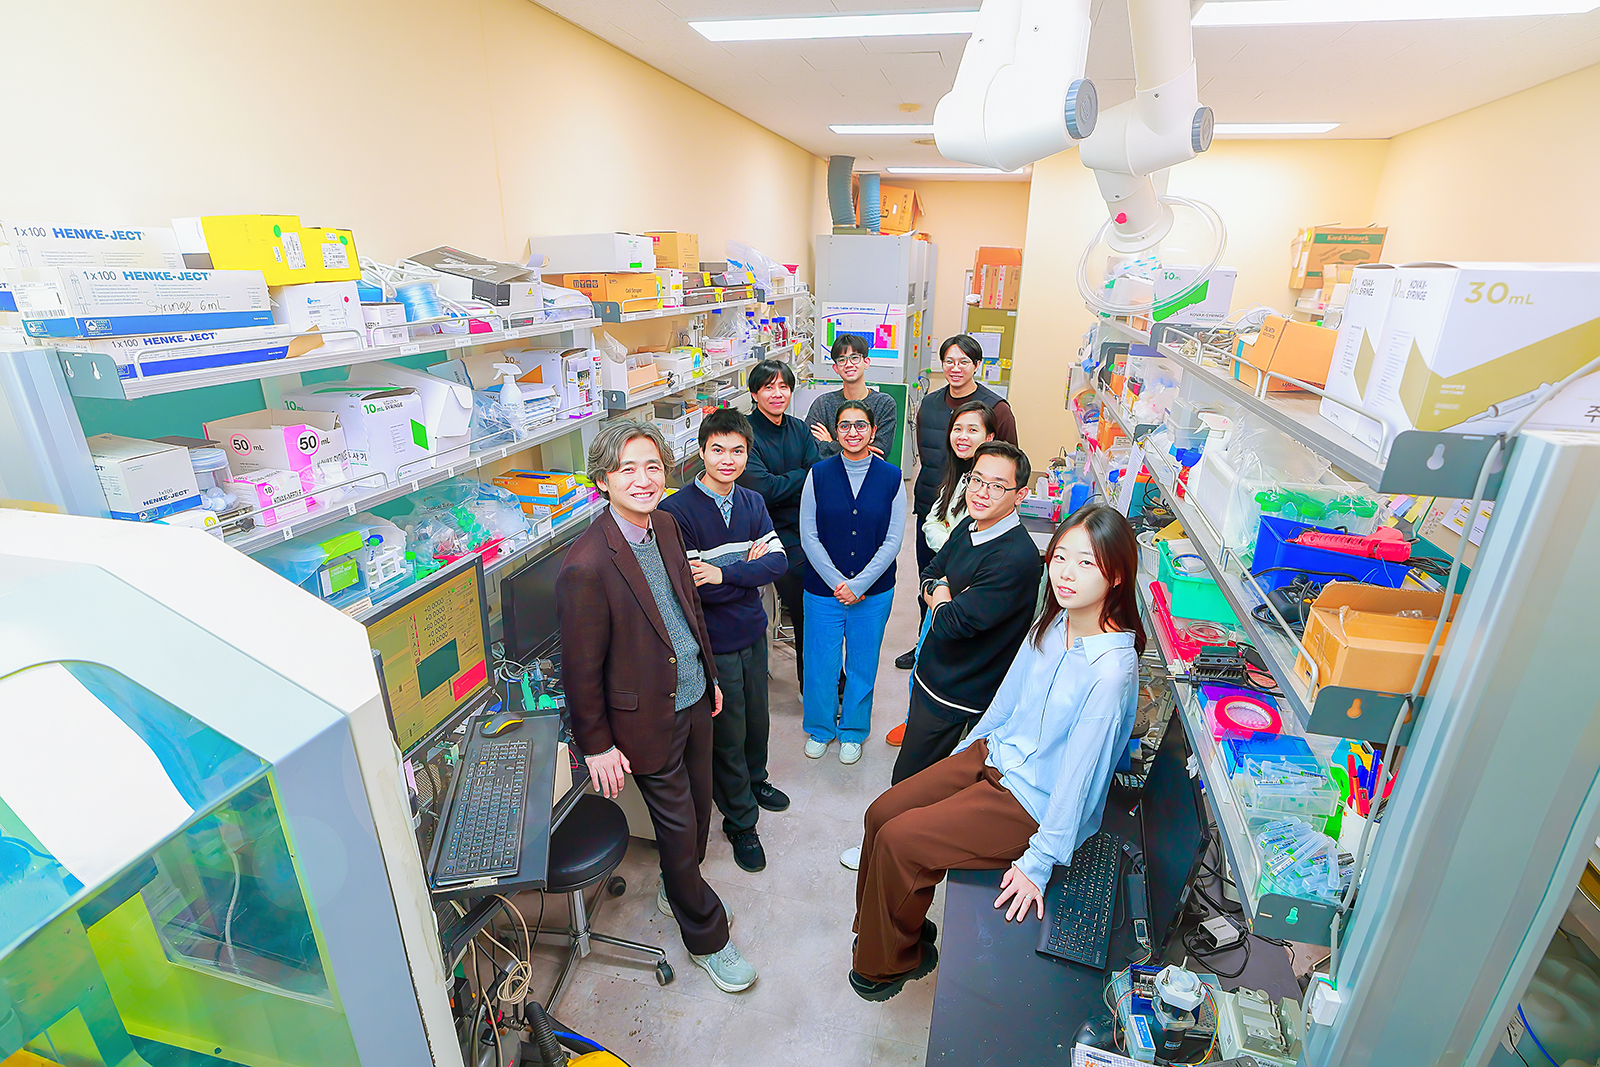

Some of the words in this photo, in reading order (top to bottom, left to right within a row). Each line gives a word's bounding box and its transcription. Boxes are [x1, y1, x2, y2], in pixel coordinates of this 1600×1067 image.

[13, 226, 47, 238] 1x100
[52, 227, 143, 241] HENKE-JECT
[83, 270, 117, 281] 1x100
[122, 271, 209, 281] HENKE-JECT
[146, 299, 194, 315] Syringe
[111, 339, 139, 349] 1x100
[143, 332, 215, 346] HENKE-JECT
[233, 439, 249, 451] 50
[300, 436, 316, 451] 50
[321, 437, 330, 446] mL
[143, 489, 188, 506] HENKE-JECT
